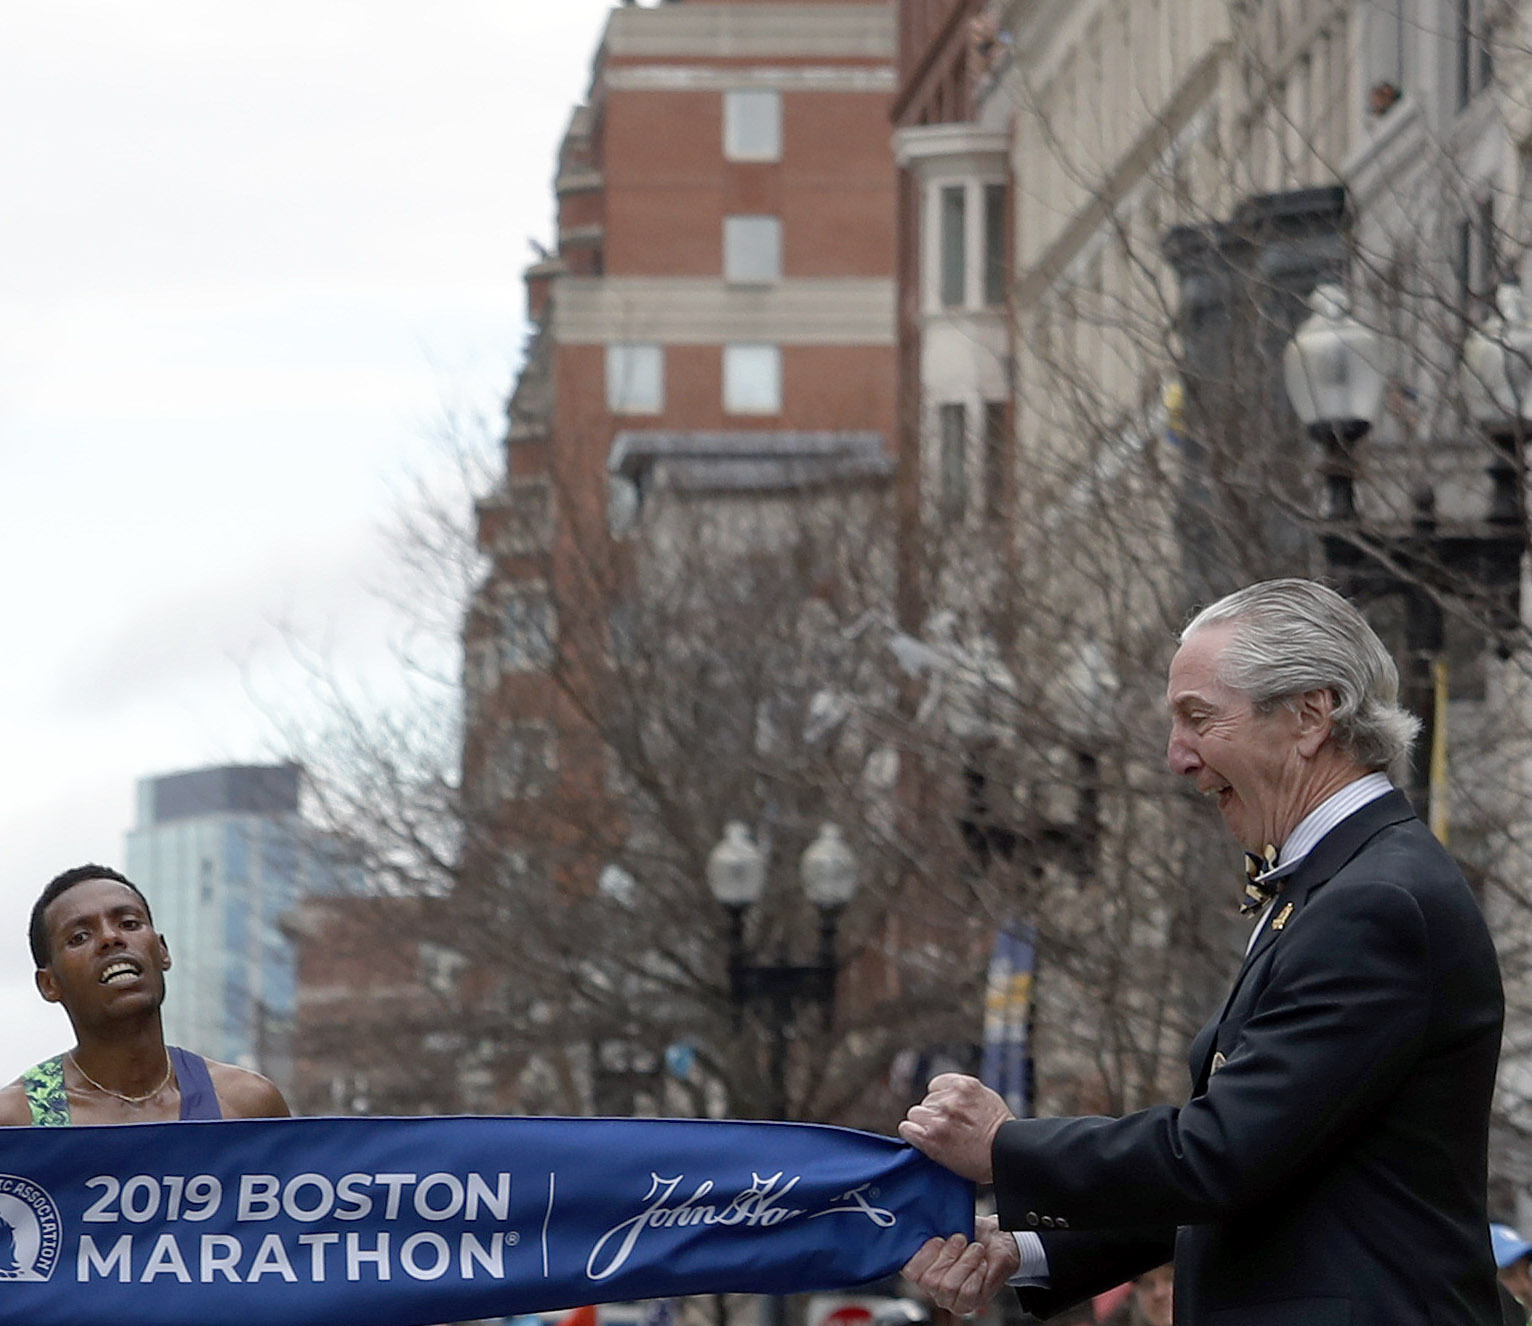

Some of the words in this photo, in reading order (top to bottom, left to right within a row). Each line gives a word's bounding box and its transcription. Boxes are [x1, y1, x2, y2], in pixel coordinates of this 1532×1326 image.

[82, 1174, 223, 1223] 2019
[237, 1172, 512, 1222] BOSTON
[11, 1182, 57, 1271] ASSOCIATION
[75, 1231, 506, 1284] MARATHON
